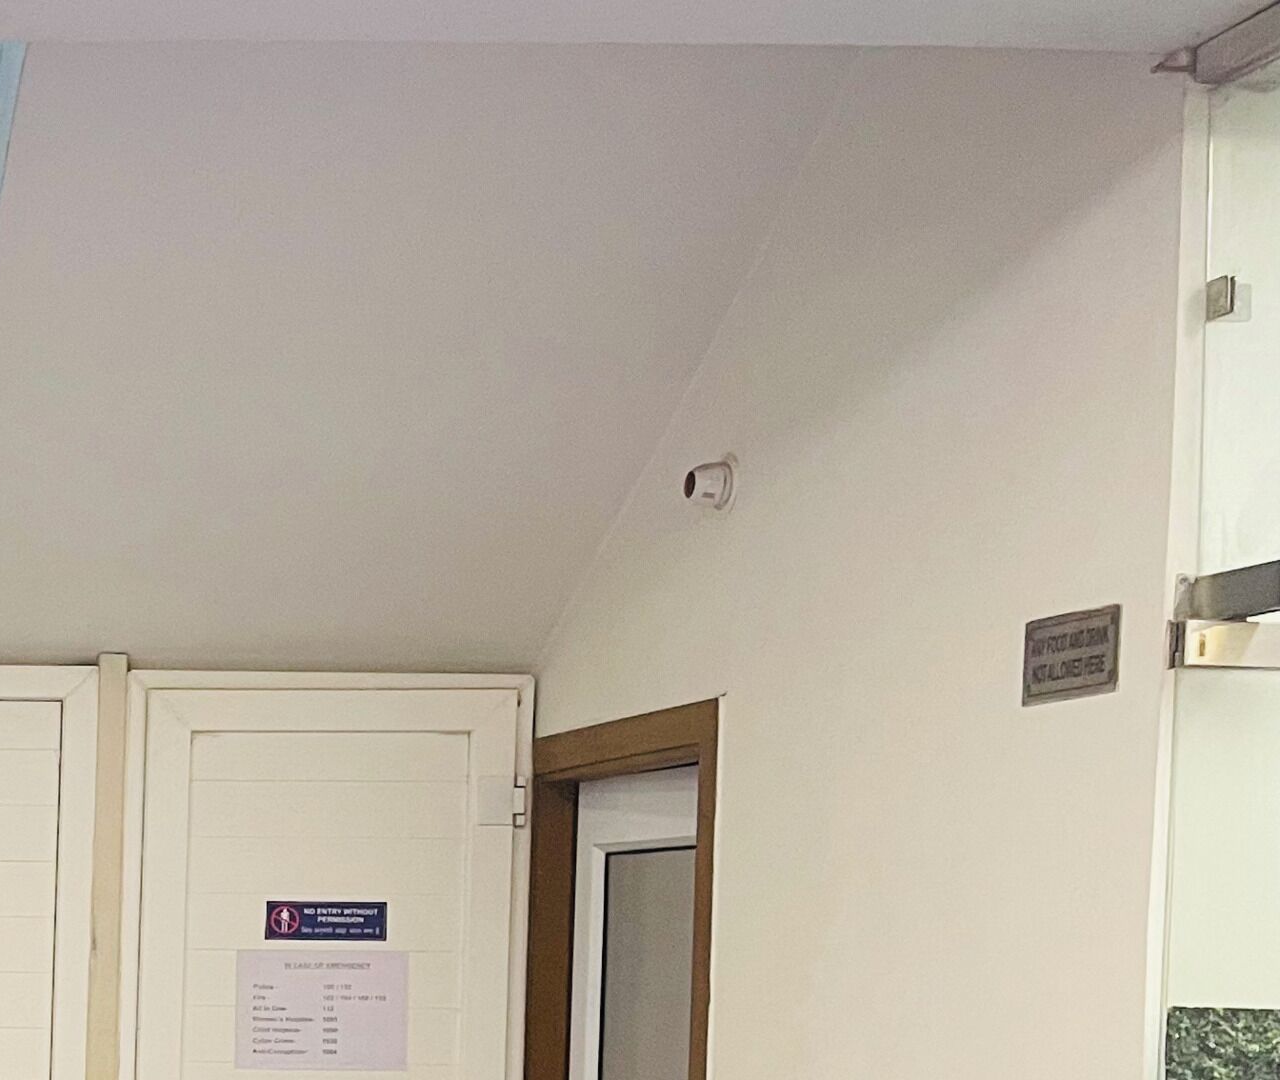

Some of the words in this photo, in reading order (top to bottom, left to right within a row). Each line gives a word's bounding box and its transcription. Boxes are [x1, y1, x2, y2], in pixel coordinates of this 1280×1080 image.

[303, 907, 316, 915] NO
[316, 907, 342, 915] ENTRY
[343, 907, 378, 916] WITHOUT
[317, 915, 365, 924] PERMISSION
